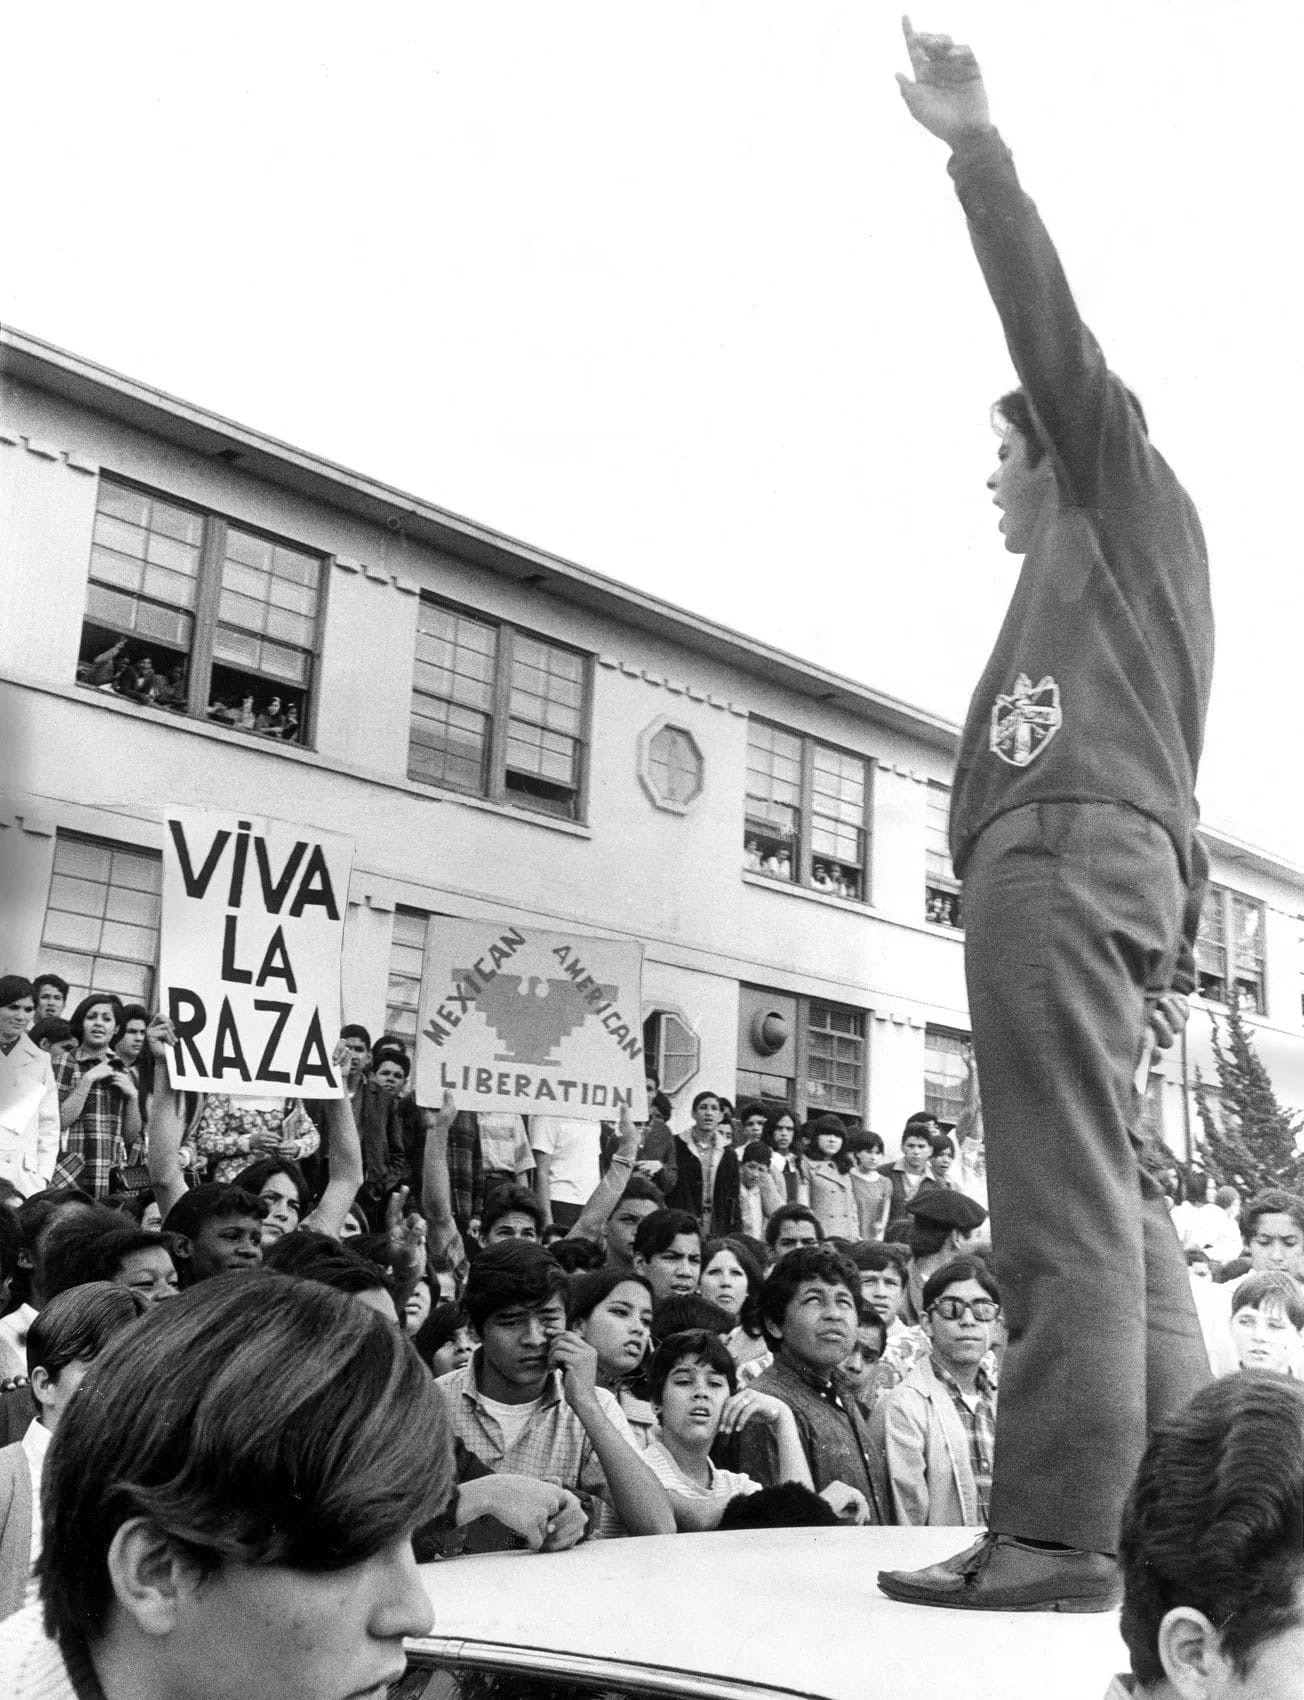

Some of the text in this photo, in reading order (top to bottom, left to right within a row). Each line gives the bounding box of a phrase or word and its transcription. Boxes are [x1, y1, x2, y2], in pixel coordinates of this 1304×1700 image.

[222, 915, 297, 993] LA
[423, 926, 643, 1060] MEXICAN AMERICAN
[169, 986, 338, 1088] RAZA
[440, 1062, 633, 1108] LIBERATION
